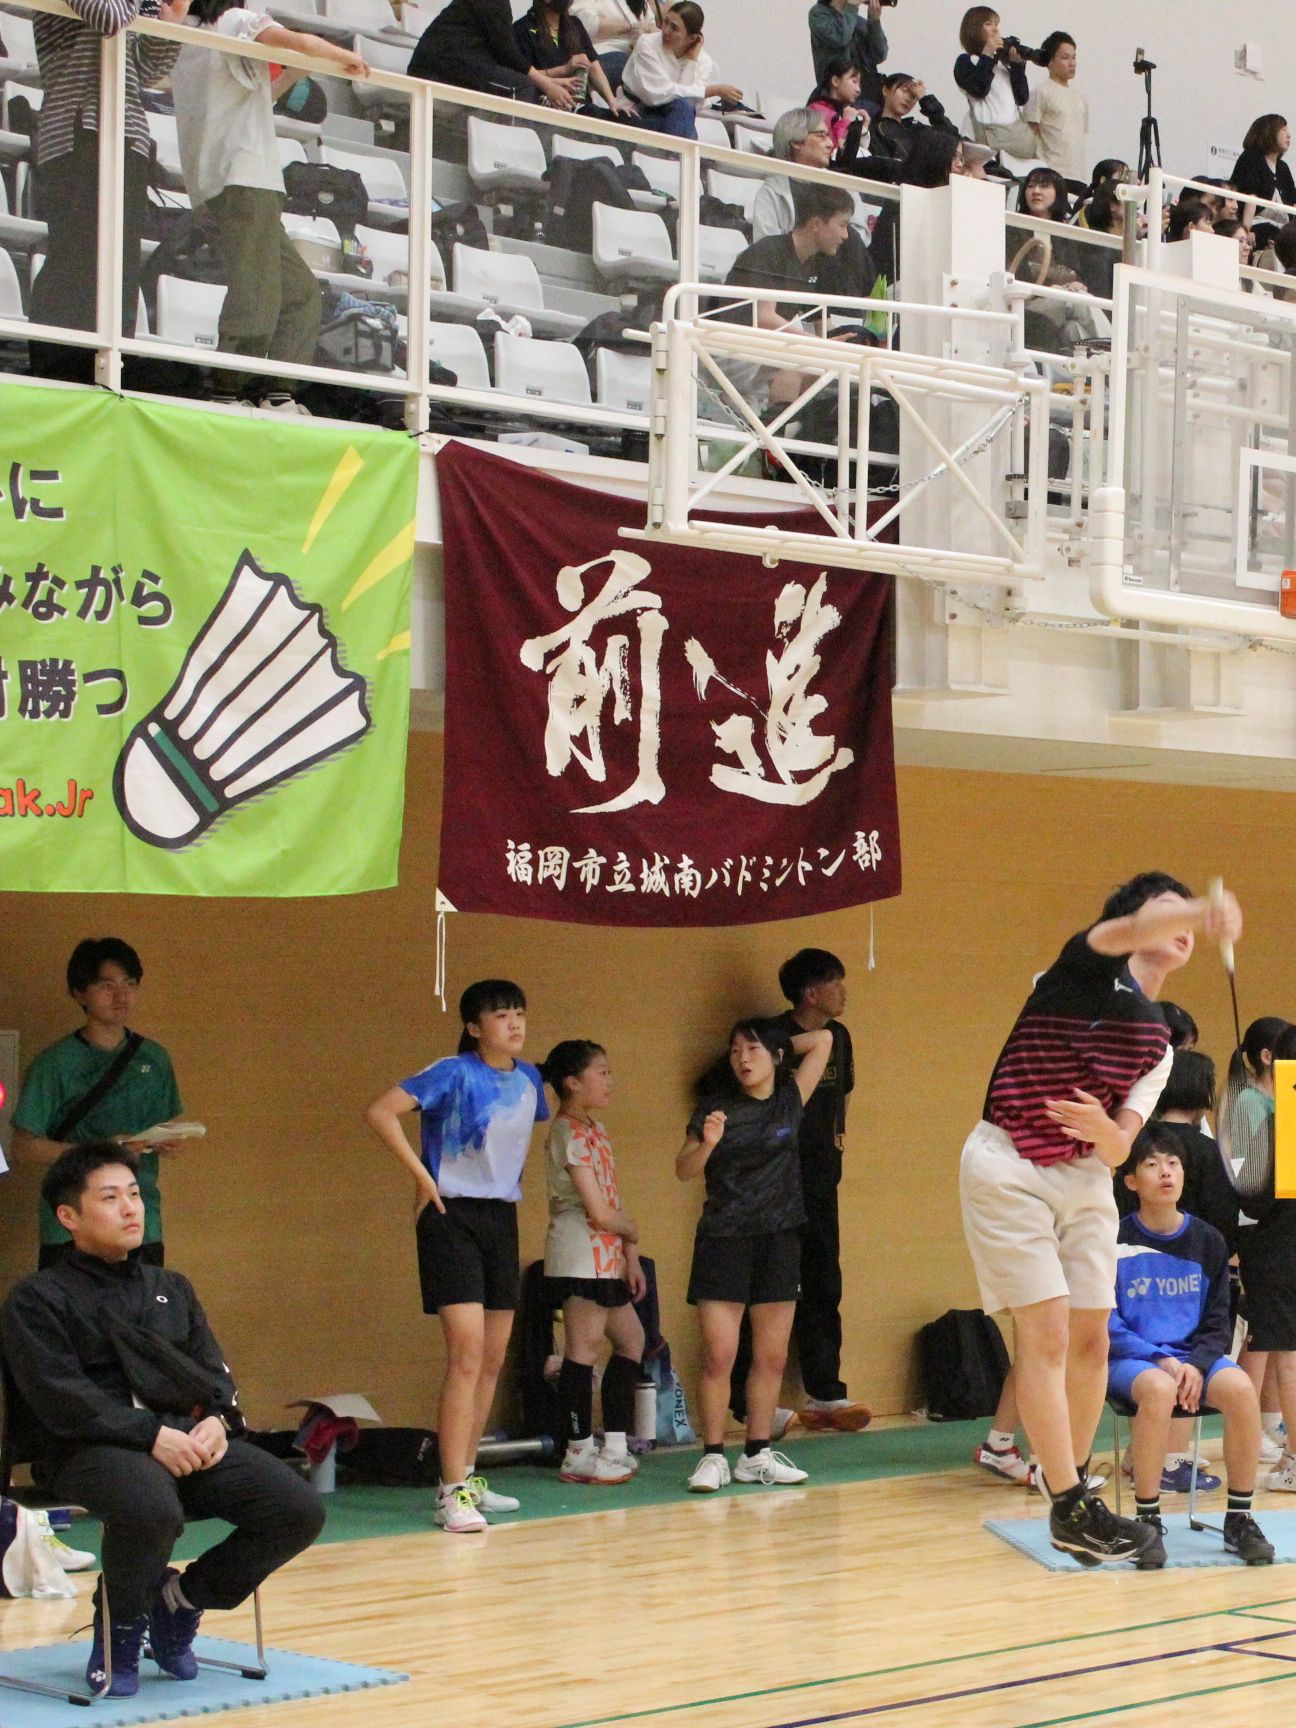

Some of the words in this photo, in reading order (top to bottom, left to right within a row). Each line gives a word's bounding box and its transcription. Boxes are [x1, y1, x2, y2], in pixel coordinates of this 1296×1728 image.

[0, 461, 66, 521] に
[0, 657, 129, 721] 勝つ
[519, 550, 854, 814] 前進
[505, 829, 883, 898] 福岡市立城南バドミントン部
[1155, 1273, 1202, 1296] YONE
